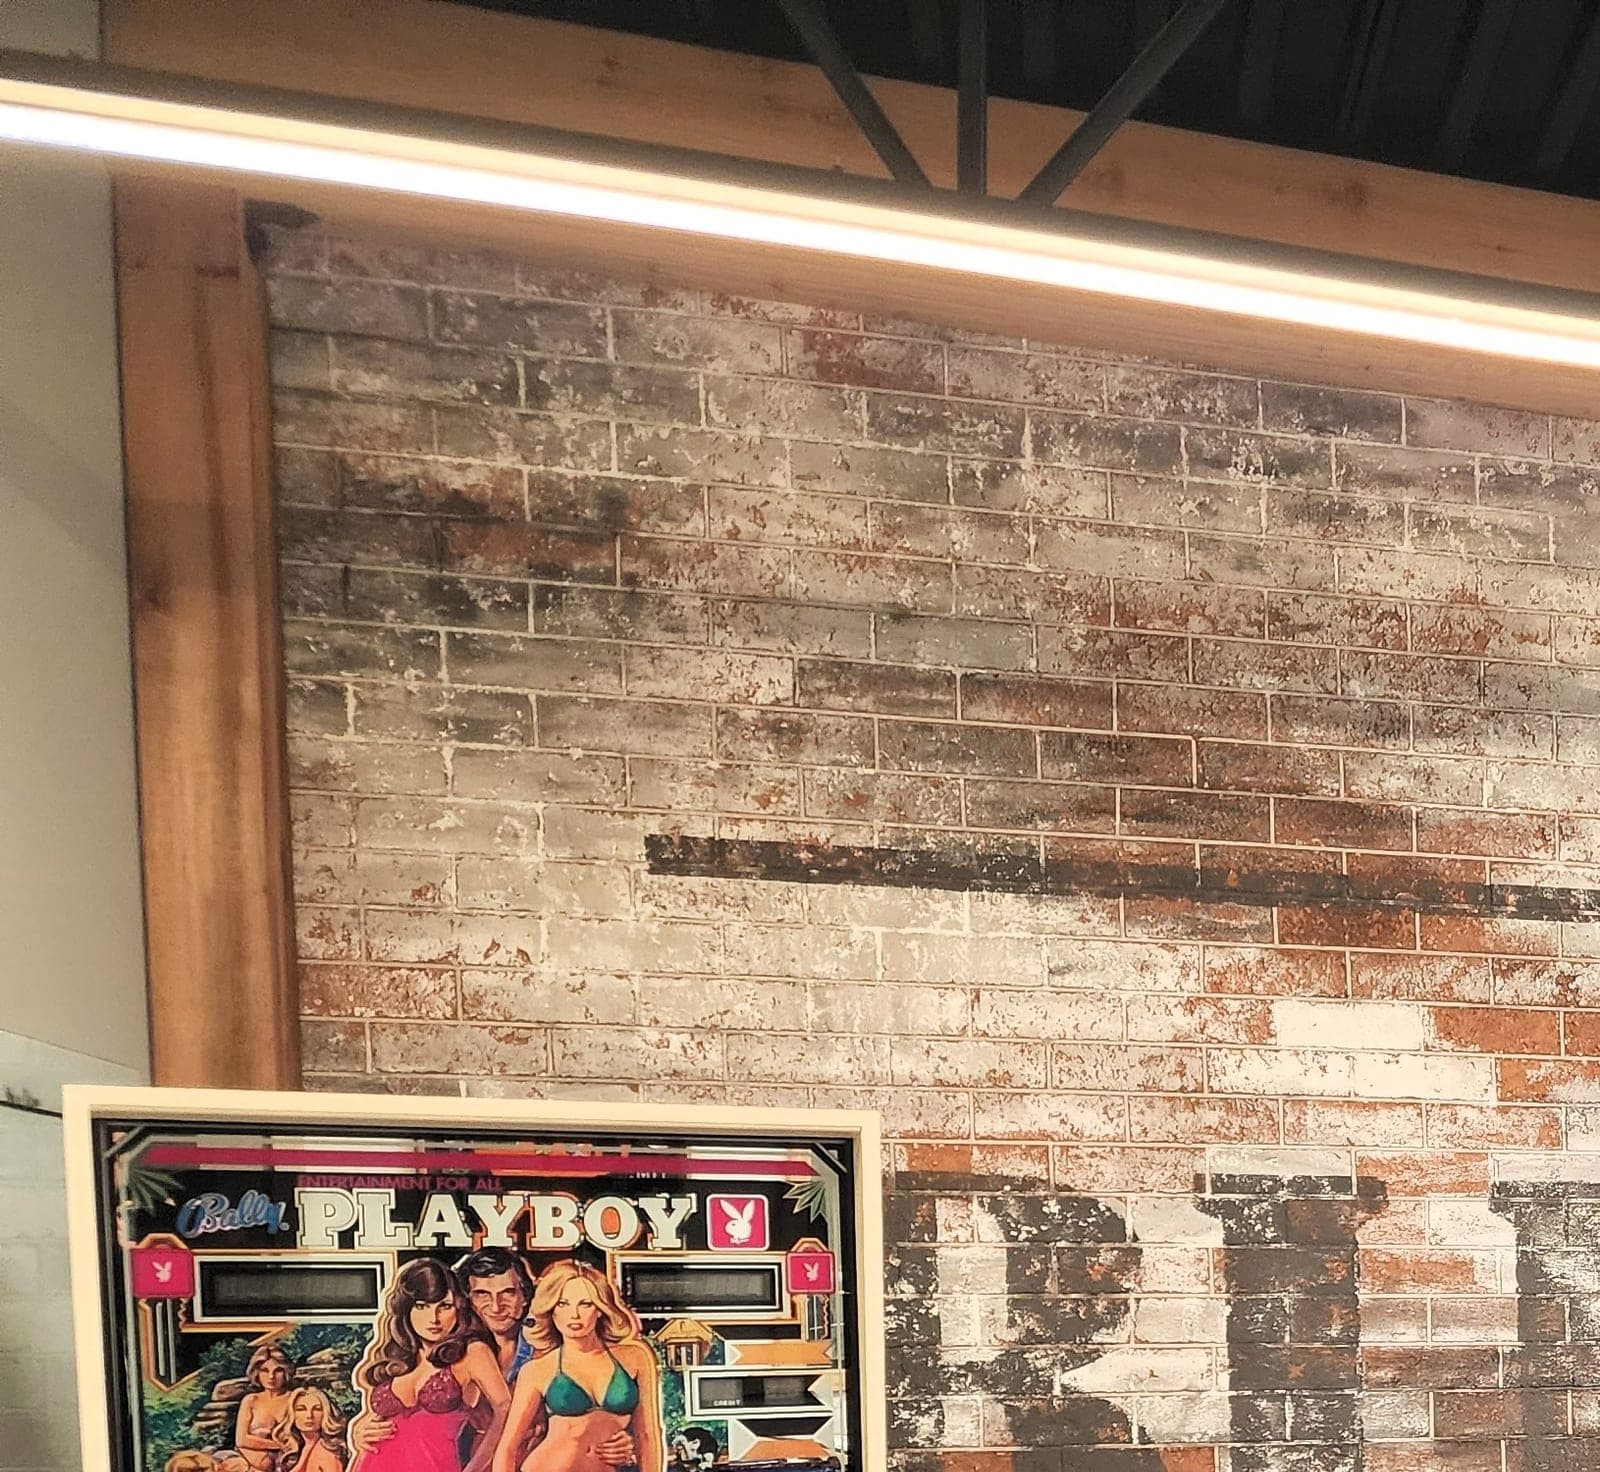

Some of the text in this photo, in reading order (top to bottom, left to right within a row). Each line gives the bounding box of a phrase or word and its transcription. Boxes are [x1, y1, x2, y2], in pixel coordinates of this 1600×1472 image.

[298, 1174, 503, 1193] ENTERTAINMENT FOR ALL
[175, 1189, 286, 1239] Bally
[294, 1186, 698, 1250] PLAYBOY
